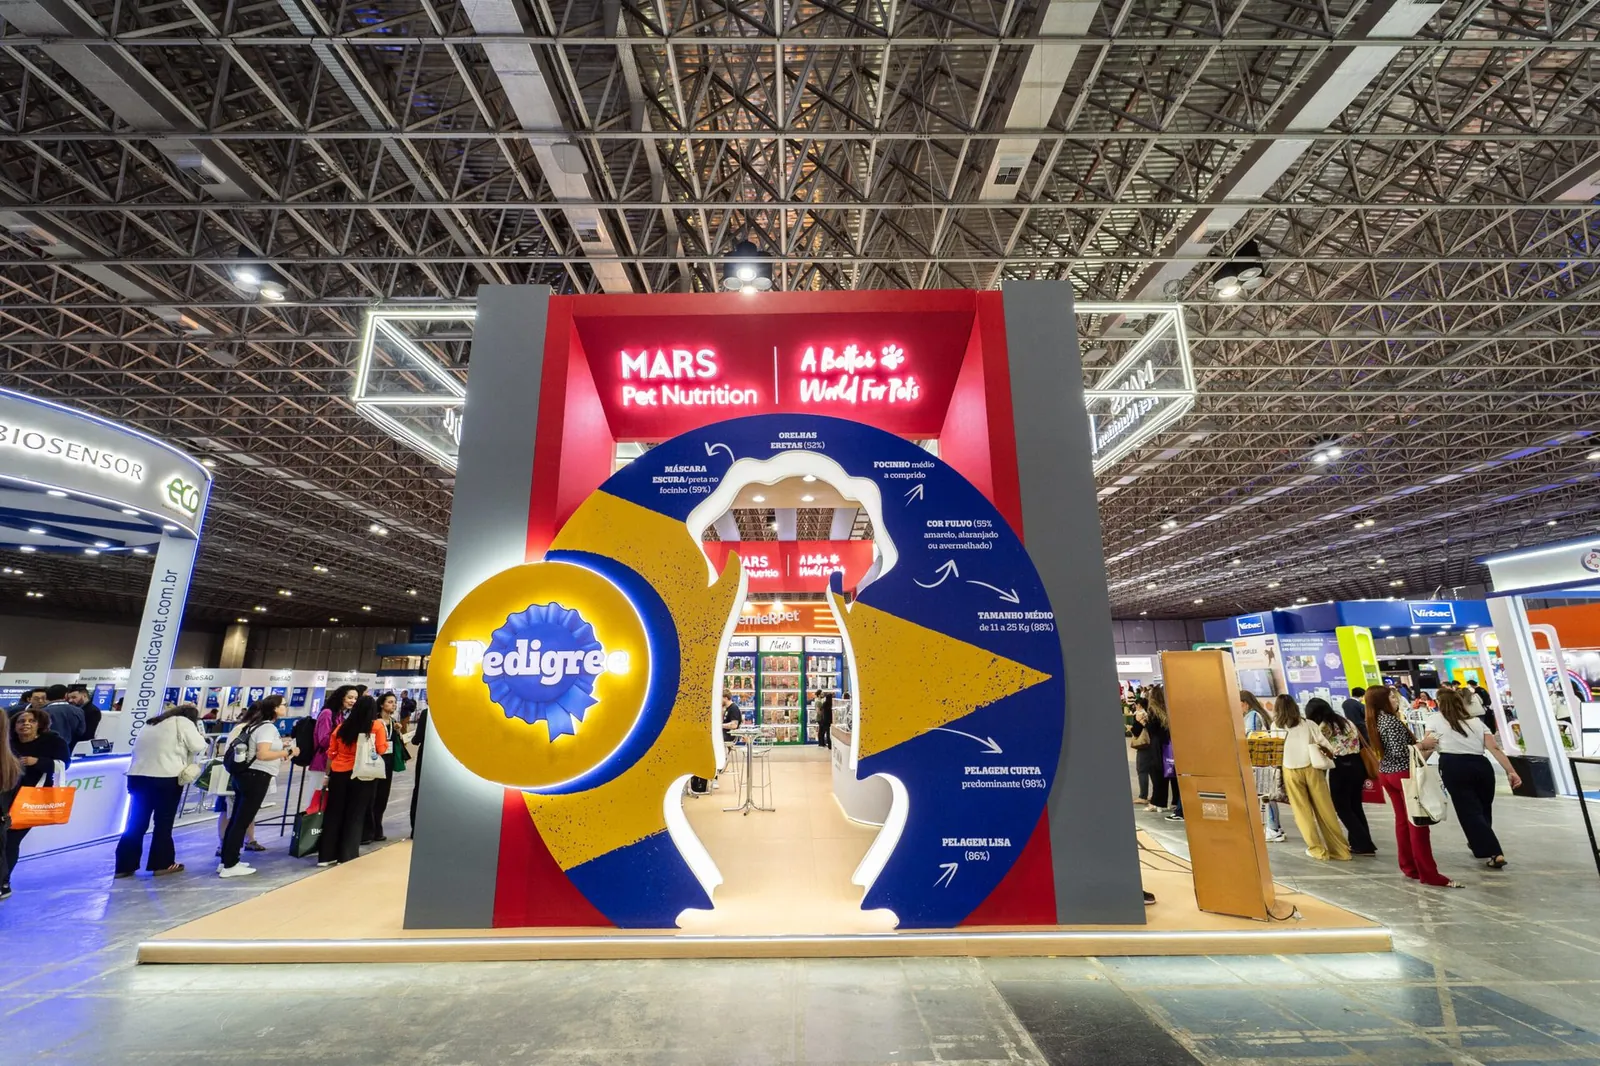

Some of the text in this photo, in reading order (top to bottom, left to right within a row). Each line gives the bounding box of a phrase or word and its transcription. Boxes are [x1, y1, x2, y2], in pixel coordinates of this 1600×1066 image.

[621, 348, 718, 379] MARS
[800, 344, 876, 375] A Better
[800, 374, 920, 404] World For Pets
[622, 384, 758, 406] Pet Nutrition
[778, 431, 817, 439] ORELHAS
[803, 441, 826, 450] (52%)
[664, 464, 708, 473] MÁSCARA
[652, 475, 708, 484] ESCURA/preta
[890, 471, 926, 480] comprido
[689, 485, 712, 494] (59%)
[167, 478, 200, 513] eco
[973, 519, 993, 528] (55%
[923, 531, 999, 540] amarelo, alaranjado
[939, 541, 993, 550] avermelhado)
[740, 555, 769, 567] ARS
[738, 610, 800, 625] emieRpet
[978, 610, 1054, 619] TAMANHO MÉDIO
[1413, 609, 1451, 618] Virbac
[1018, 624, 1030, 633] Kg
[1030, 623, 1054, 632] (88%)
[1238, 622, 1262, 630] Virbac
[450, 638, 630, 686] Pedigree
[964, 766, 1041, 775] PELAGEM CURTA
[65, 775, 105, 791] OTE
[961, 778, 1046, 789] predominante (98%)
[942, 838, 1011, 846] PELAGEM LISA
[964, 850, 990, 861] (86%)
